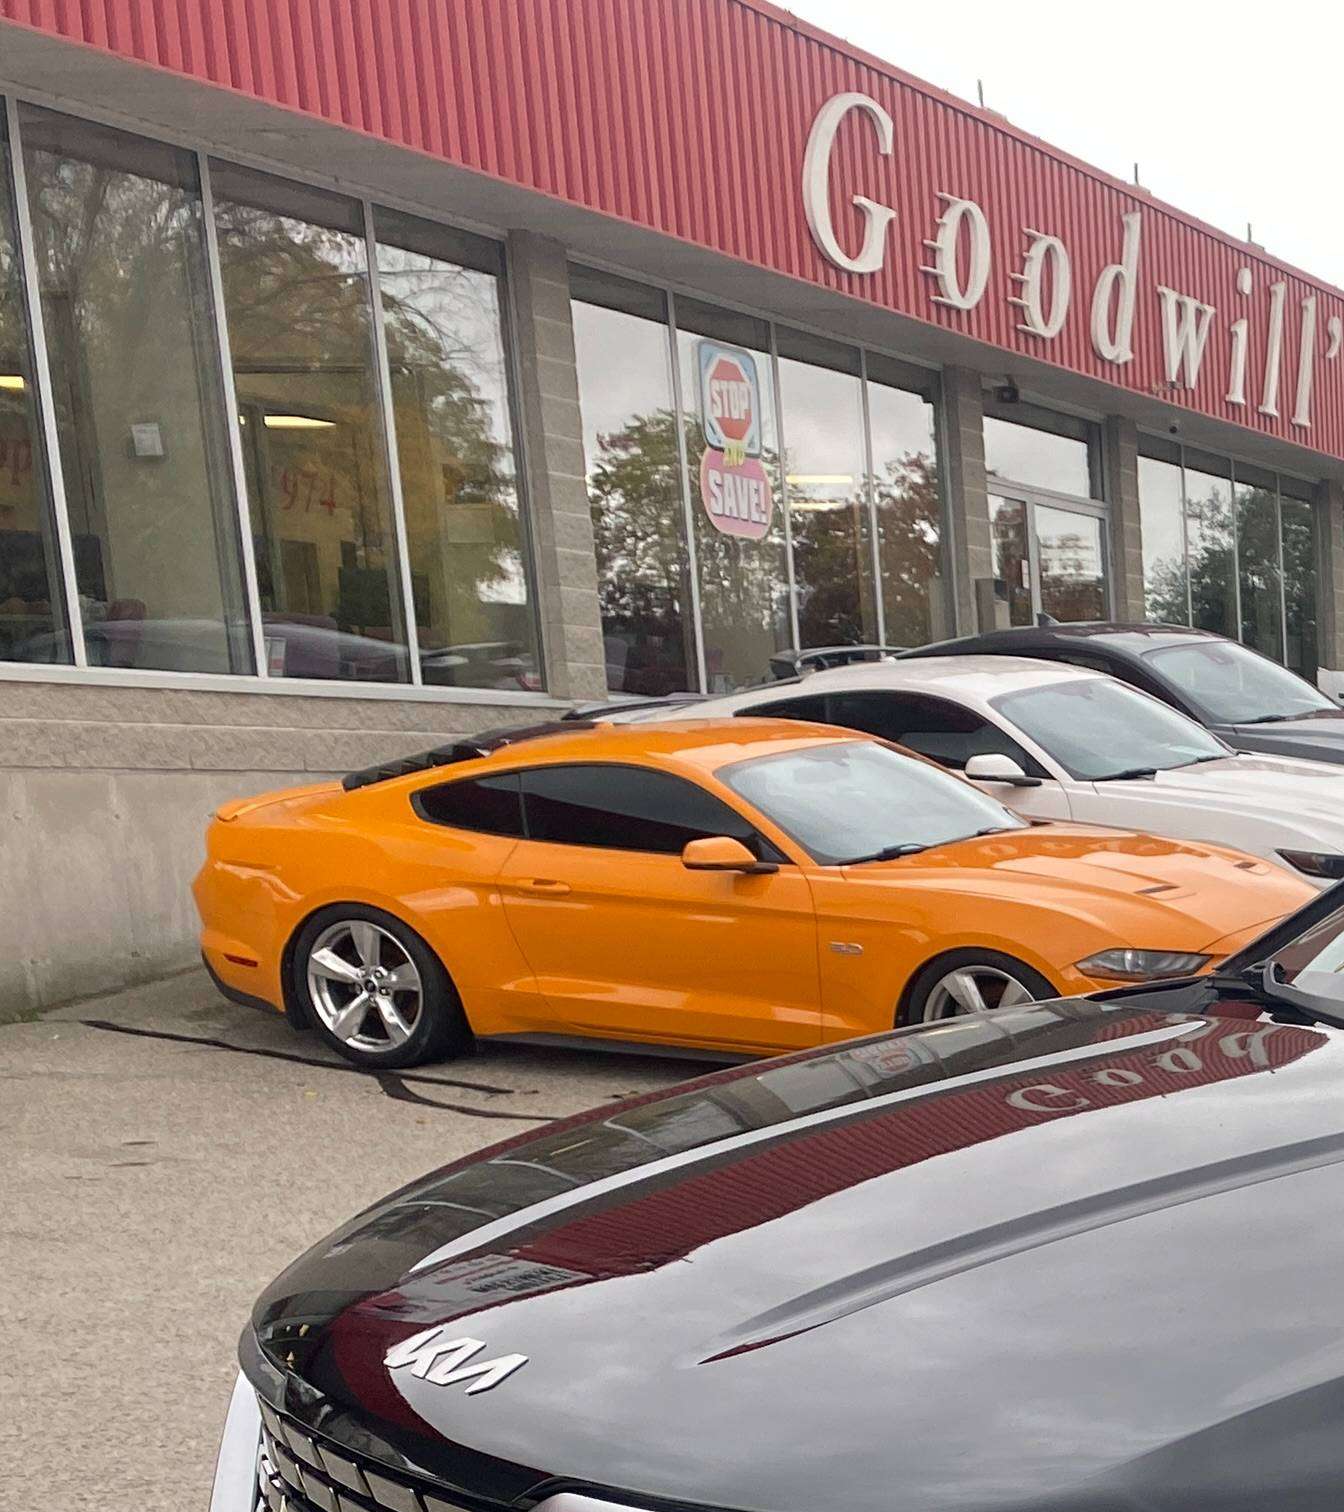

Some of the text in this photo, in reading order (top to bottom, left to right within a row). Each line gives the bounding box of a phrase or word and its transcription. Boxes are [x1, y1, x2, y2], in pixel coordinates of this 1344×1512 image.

[709, 377, 752, 421] STOP
[708, 468, 768, 526] SAVE!
[382, 1325, 530, 1396] KIA
